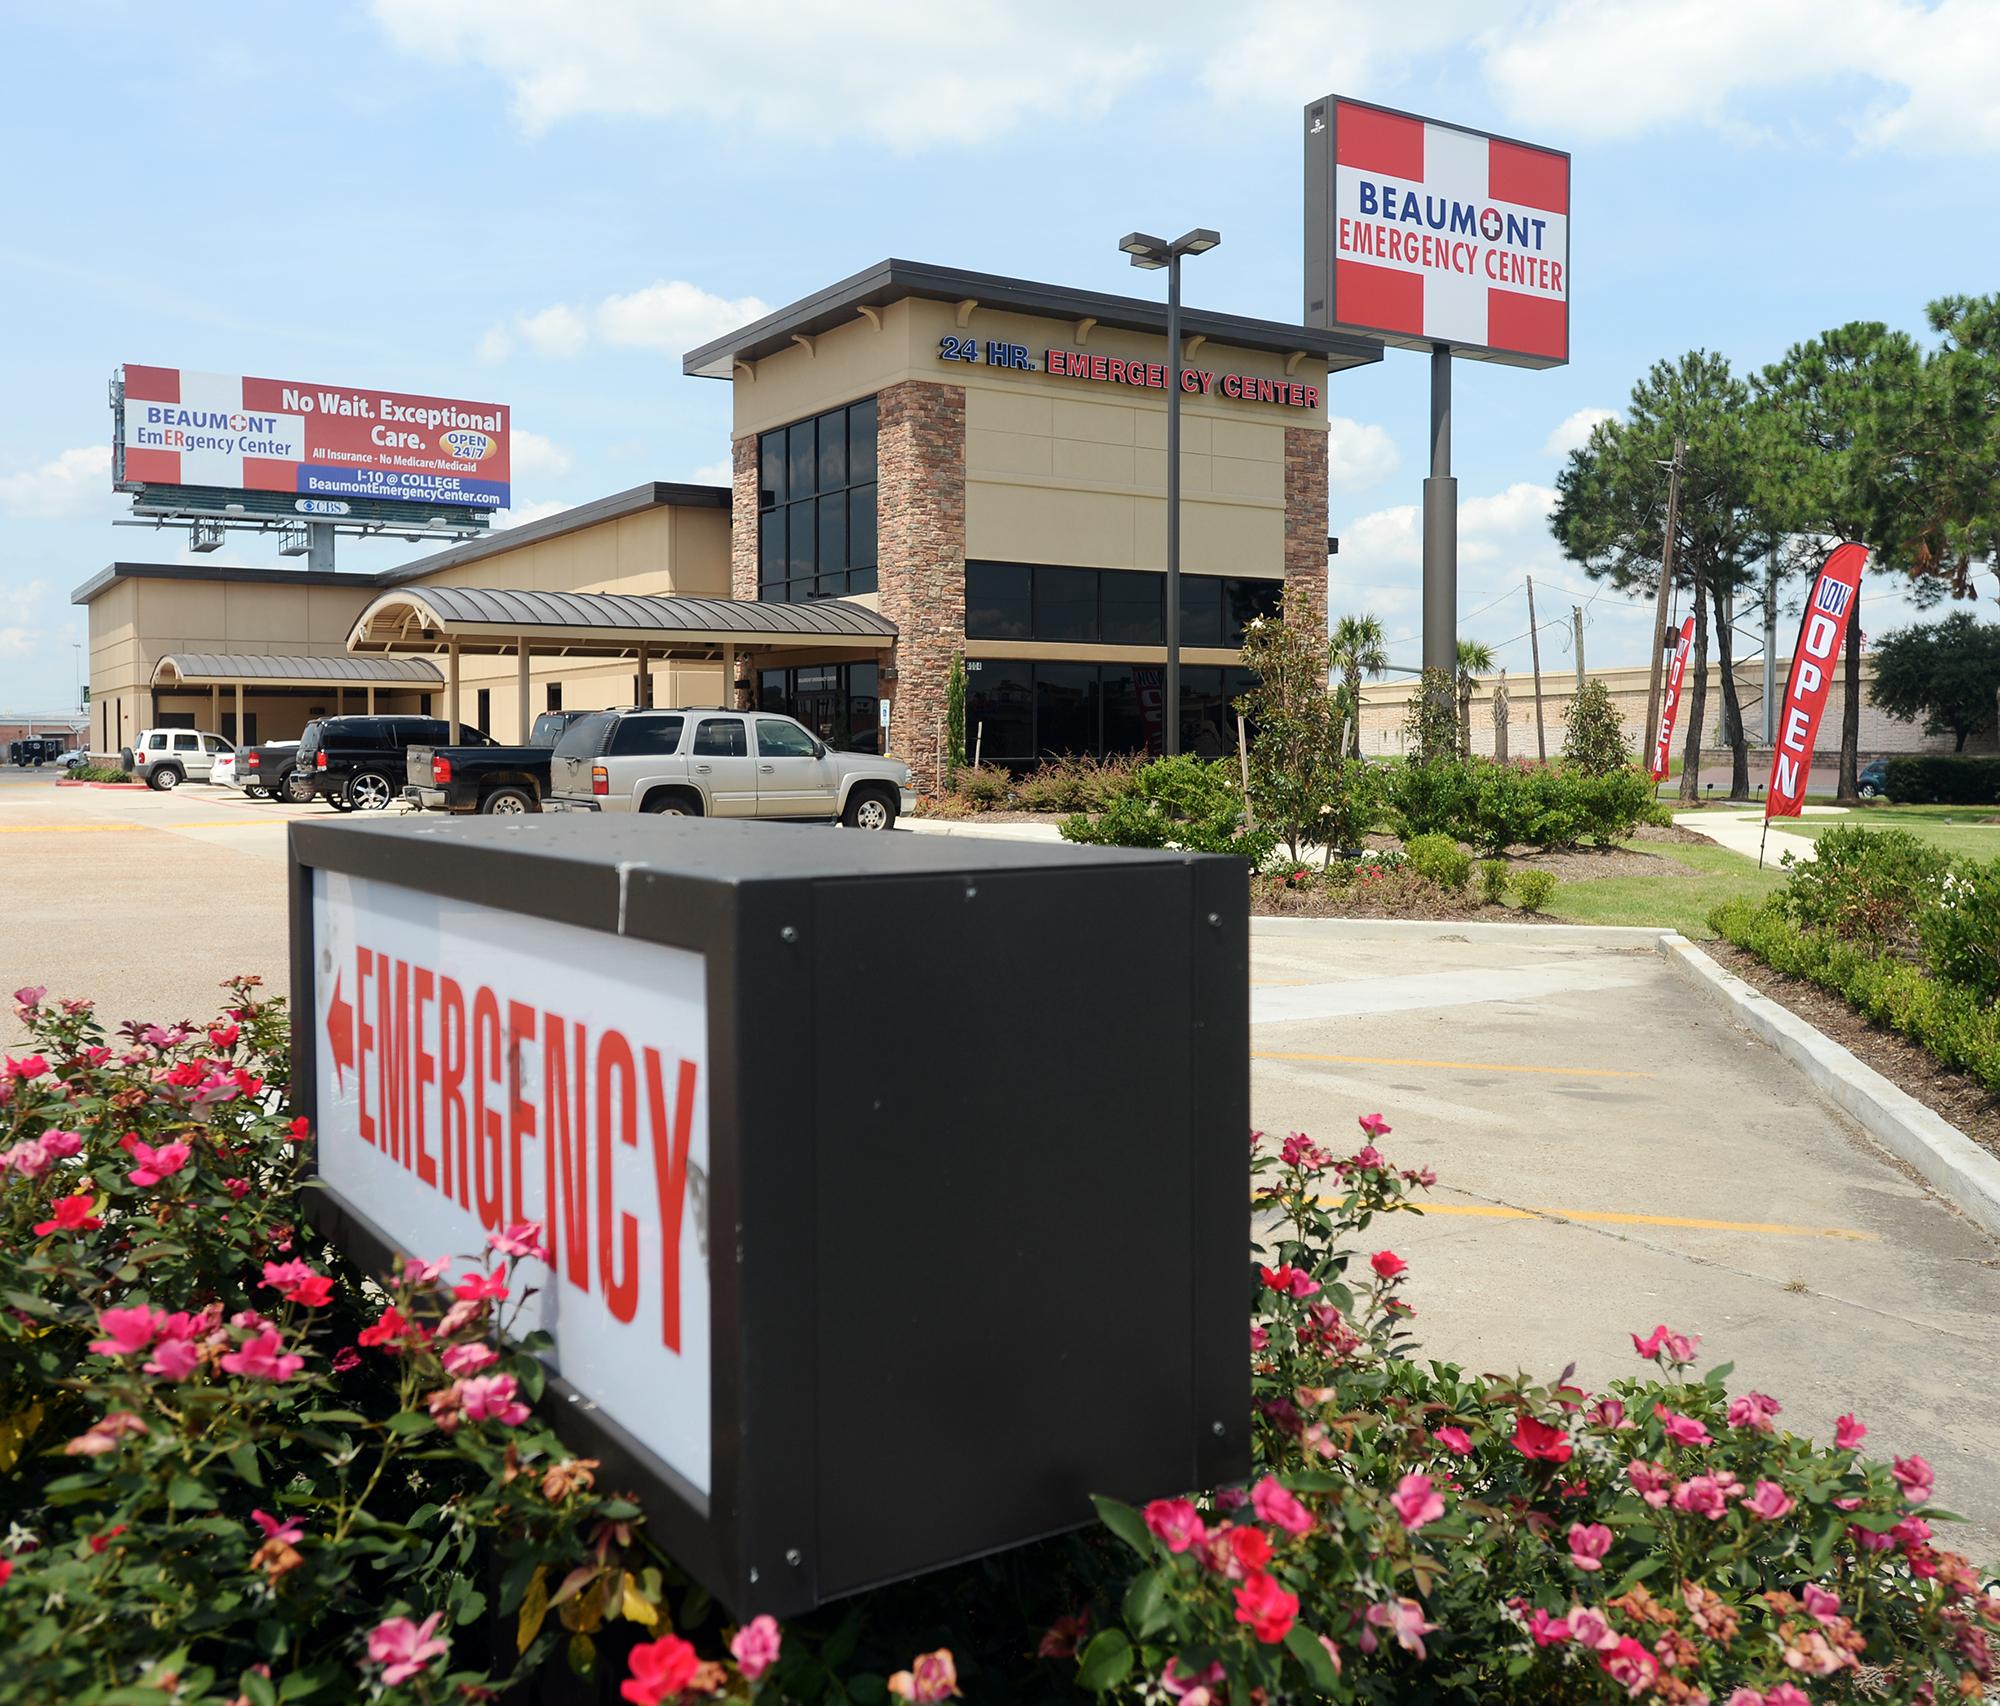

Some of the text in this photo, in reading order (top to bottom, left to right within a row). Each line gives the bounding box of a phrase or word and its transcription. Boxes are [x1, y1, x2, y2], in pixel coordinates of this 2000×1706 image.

[1360, 180, 1546, 250] BEAUMONT
[1339, 217, 1563, 292] EMERGENCY CENTER
[941, 335, 979, 363] 24
[987, 340, 1038, 372] HR.
[1223, 373, 1320, 409] CENTER
[148, 407, 277, 434] BEAUMONT
[282, 388, 502, 432] No Wait. Exceptional
[138, 427, 292, 456] EmERgency Center
[371, 424, 426, 450] Care.
[447, 433, 487, 447] OPEN
[313, 447, 326, 459] All
[327, 448, 373, 464] Insurance
[379, 453, 391, 465] No
[393, 455, 477, 473] Medicare/Medicaid
[453, 445, 484, 459] 24/7
[309, 477, 500, 505] BeaumontEmergencyCenter.com
[358, 470, 460, 490] I-10 @ COLLEGE
[316, 501, 342, 513] CBS
[1816, 575, 1852, 616] NOW
[1774, 613, 1838, 800] OPEN
[356, 944, 697, 1356] EMERGENCY
